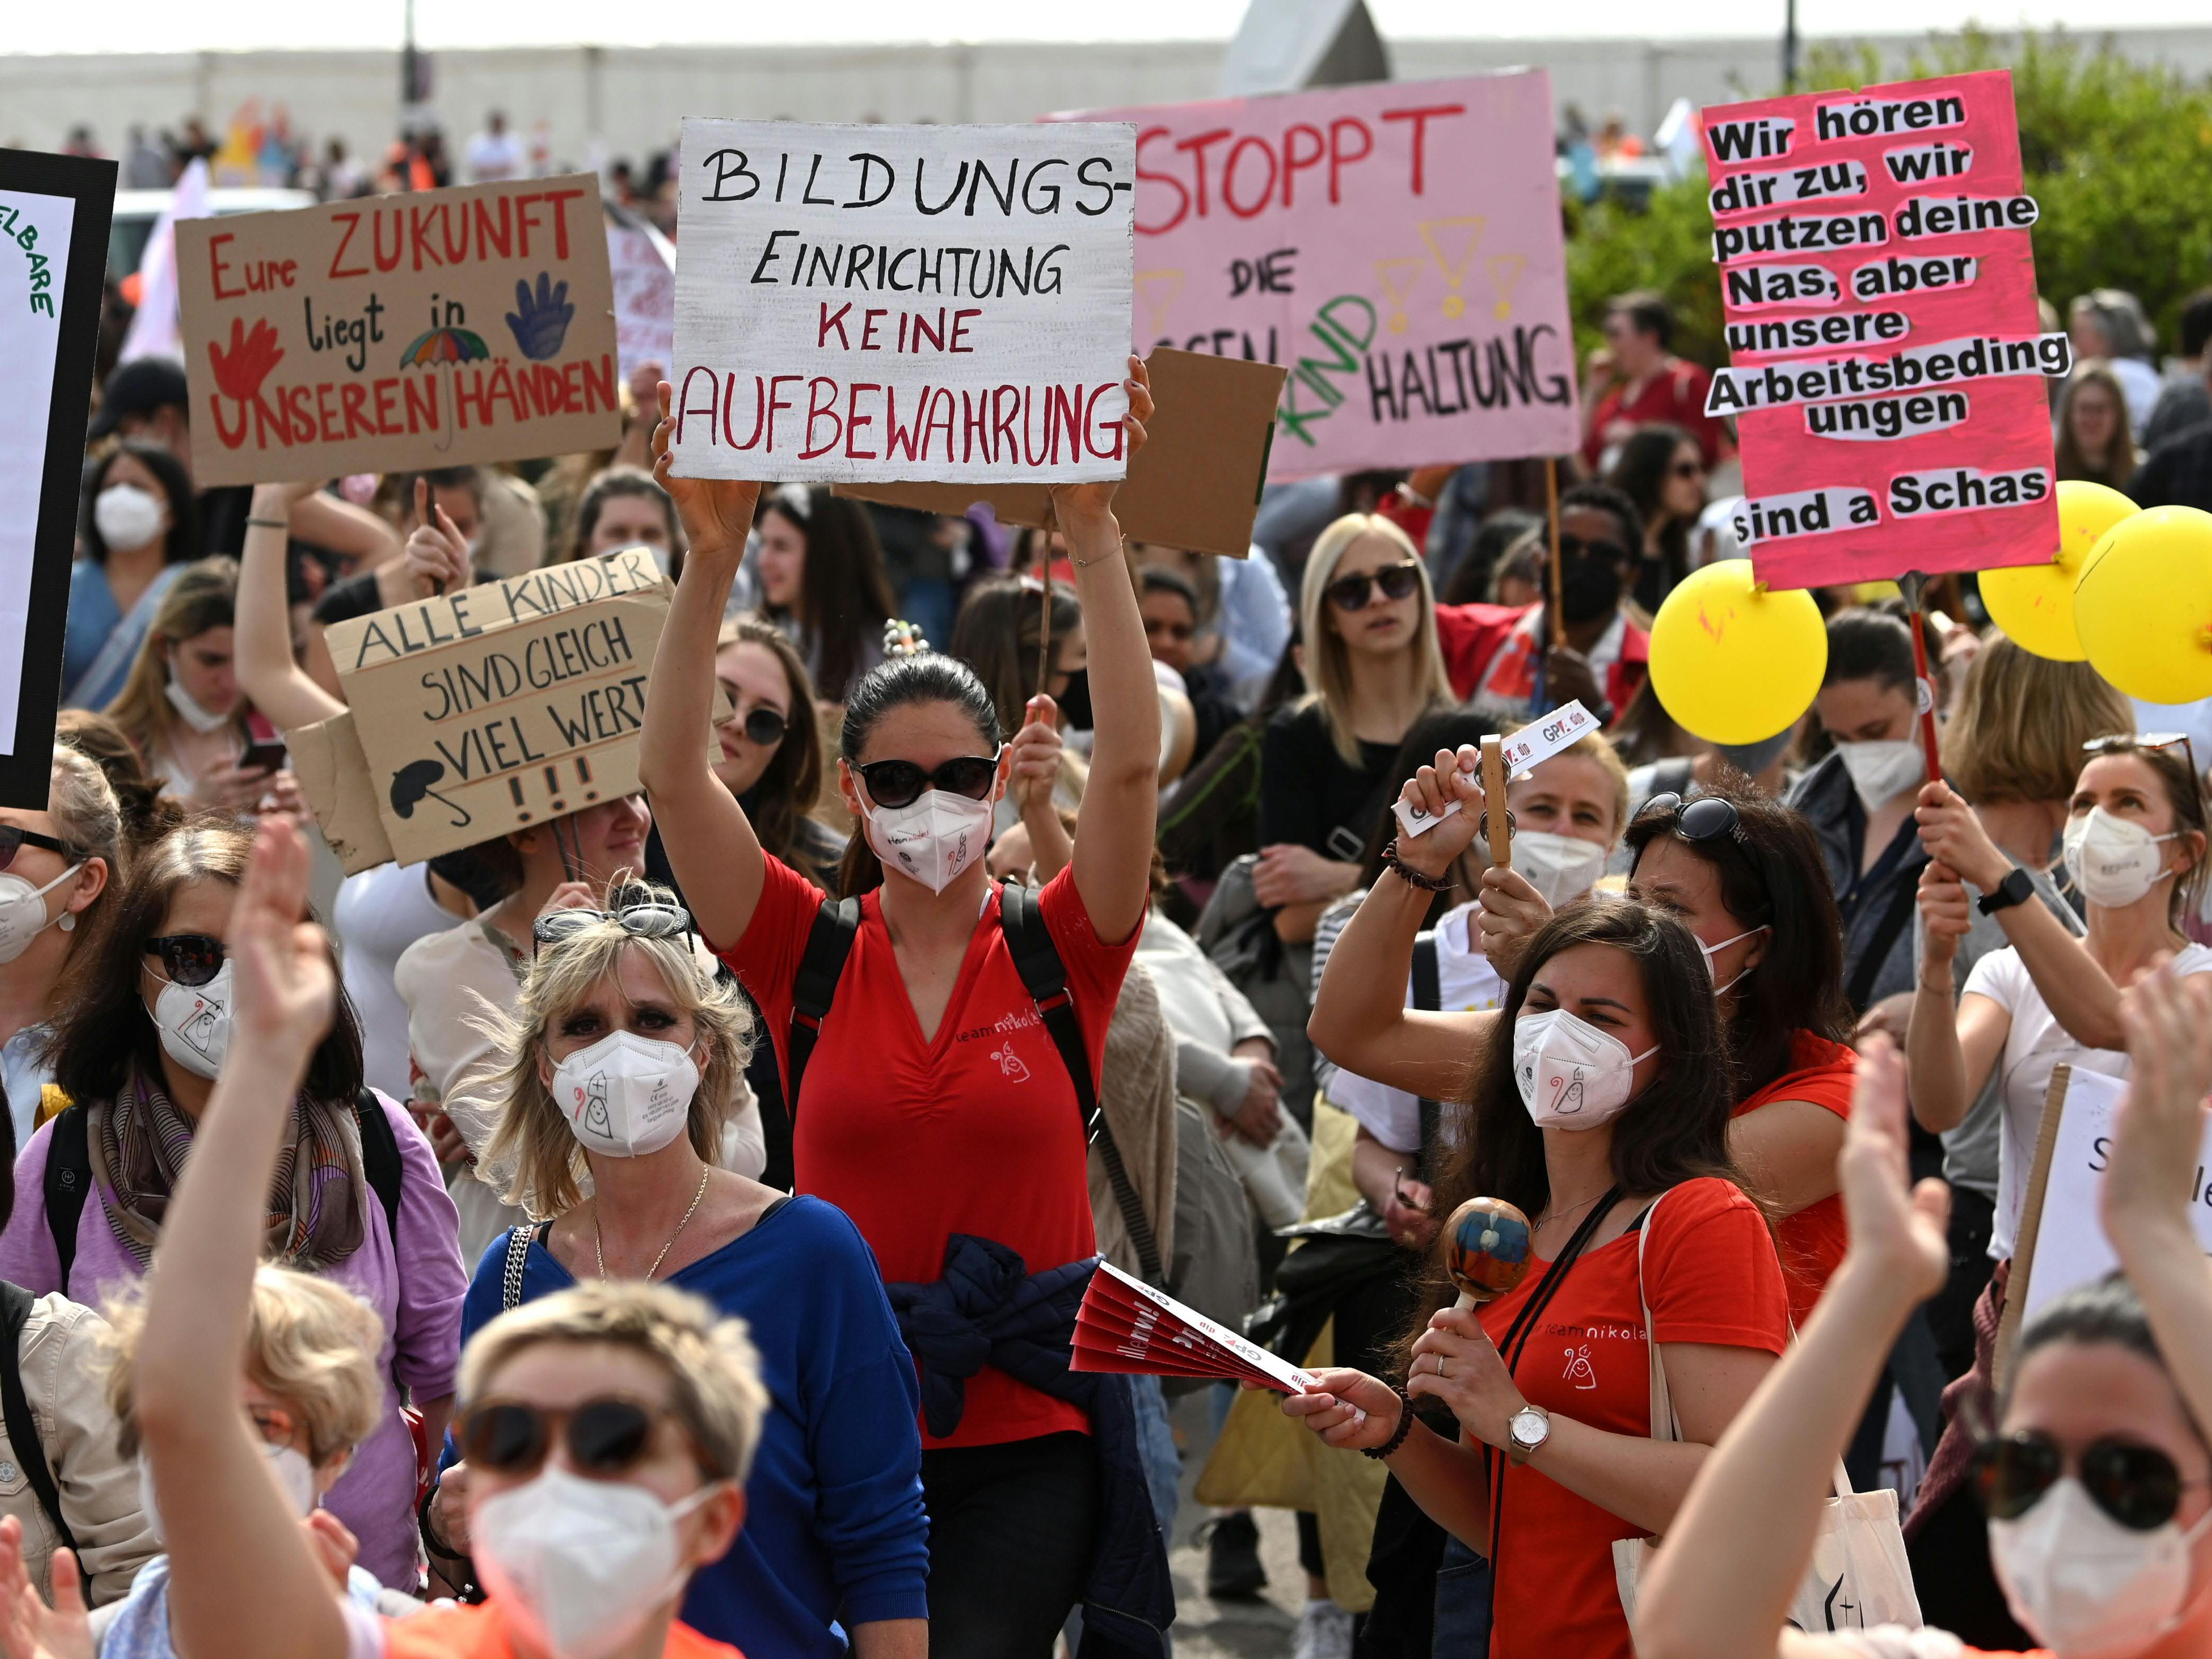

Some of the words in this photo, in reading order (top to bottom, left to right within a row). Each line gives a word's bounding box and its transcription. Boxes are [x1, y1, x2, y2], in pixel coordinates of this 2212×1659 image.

[1709, 120, 1794, 161] Wir
[1817, 96, 1965, 141] hören
[702, 149, 1132, 217] BILDUNGS-
[1134, 103, 1465, 236] STOPPT
[1710, 174, 1777, 212] dir
[1795, 162, 1867, 199] zu,
[1886, 143, 1970, 182] wir
[209, 232, 297, 300] Eure
[329, 190, 584, 278] ZUKUNFT
[1714, 213, 1887, 262] putzen
[1895, 195, 2036, 238] deine
[751, 230, 1069, 298] EINRICHTUNG
[1229, 249, 1299, 298] DIE
[1727, 266, 1840, 305] Nas,
[1856, 256, 1972, 297] aber
[304, 293, 384, 372] liegt
[431, 293, 464, 327] in
[818, 302, 982, 354] KEINE
[1728, 311, 1904, 351] unsere
[210, 374, 439, 450] UNSEREN
[454, 353, 616, 429] HÄNDEN
[1278, 295, 1378, 447] KIND
[1367, 325, 1571, 421] HALTUNG
[1708, 336, 2068, 412] Arbeitsbeding
[677, 366, 1123, 466] AUFBEWAHRUNG
[1807, 392, 1966, 437] ungen
[1733, 493, 1830, 543] sind
[1849, 494, 1878, 524] a
[1890, 471, 2047, 514] Schas
[356, 594, 483, 668] ALLE
[502, 554, 656, 623] KINDER
[434, 717, 544, 780] VIEL
[547, 676, 646, 748] WERT
